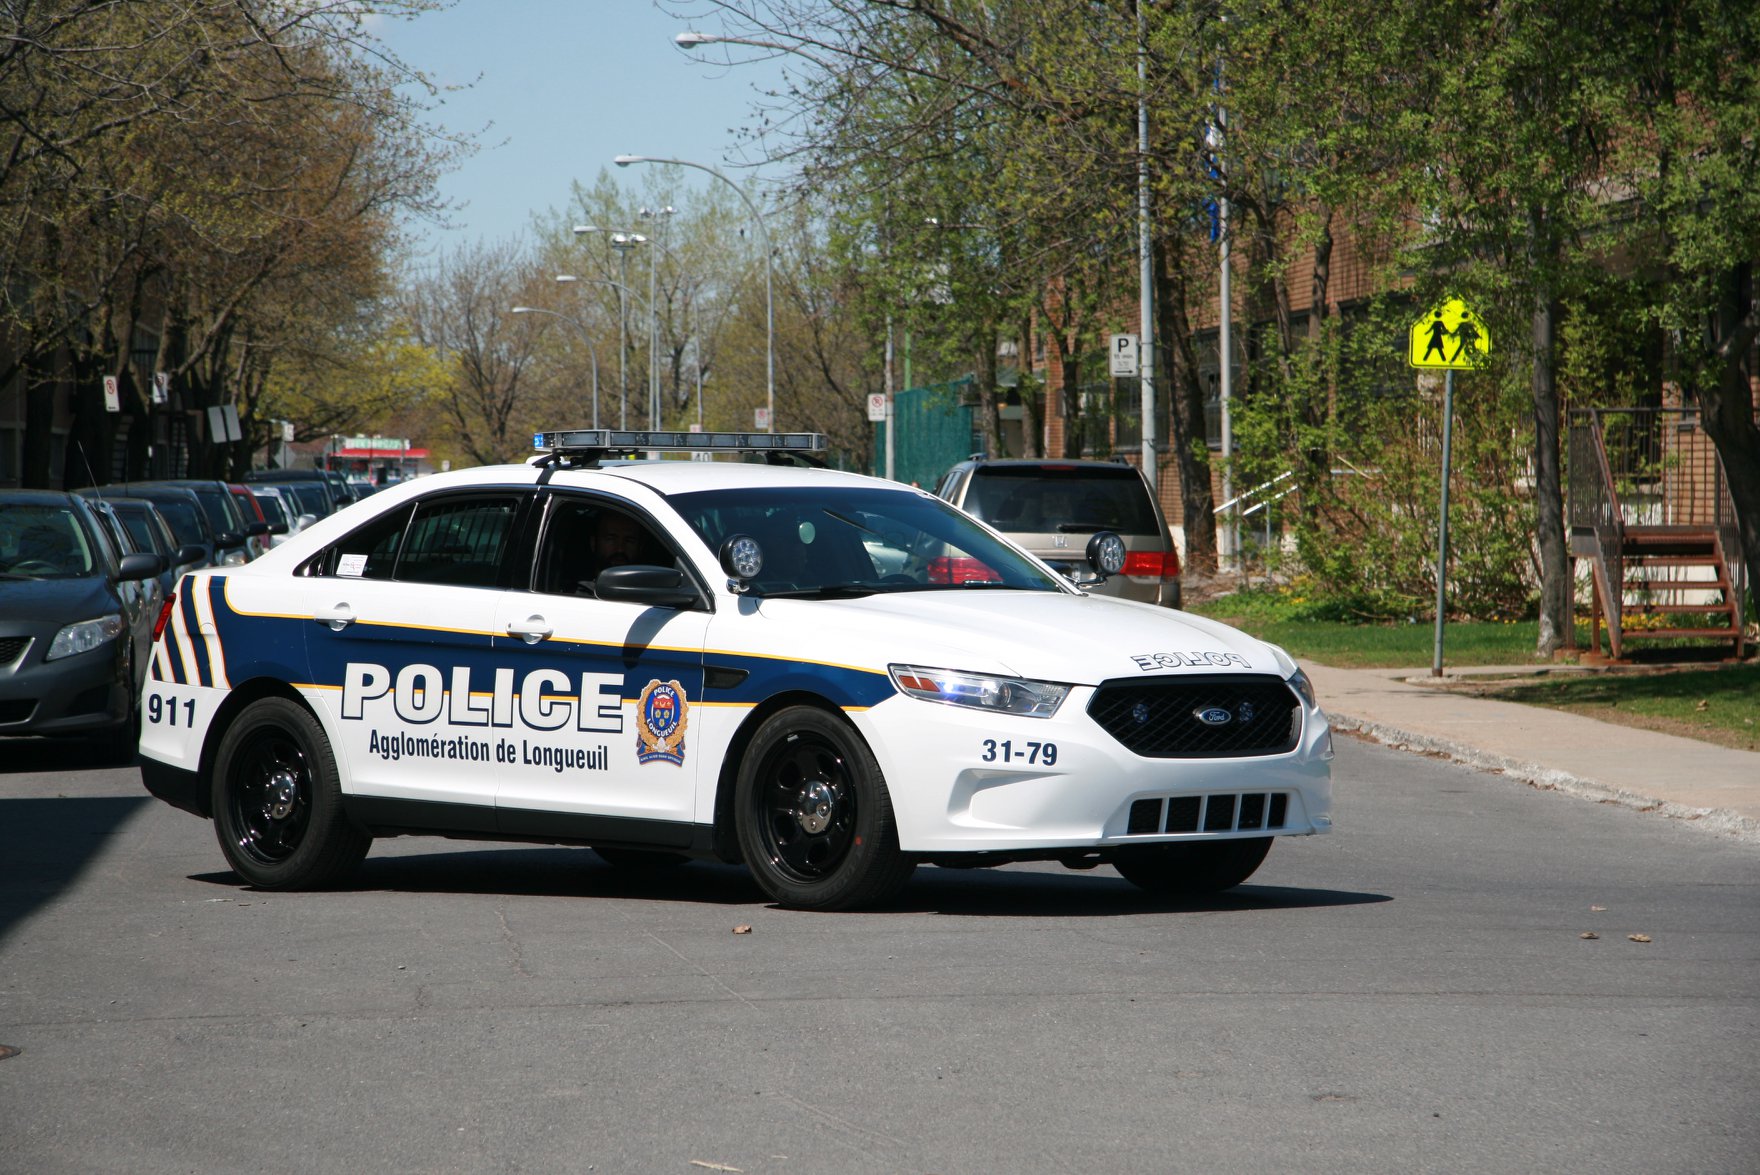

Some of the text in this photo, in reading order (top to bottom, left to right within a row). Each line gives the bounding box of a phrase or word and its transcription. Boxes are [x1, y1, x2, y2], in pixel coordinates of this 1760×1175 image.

[1118, 338, 1129, 352] P
[340, 662, 625, 734] POLICE
[653, 686, 675, 697] POLICE
[148, 693, 195, 728] 911
[1208, 711, 1225, 721] Ford
[646, 718, 678, 737] LONGUEUIL
[369, 729, 608, 773] Agglomération de Longueuil
[981, 739, 1058, 766] 31-79
